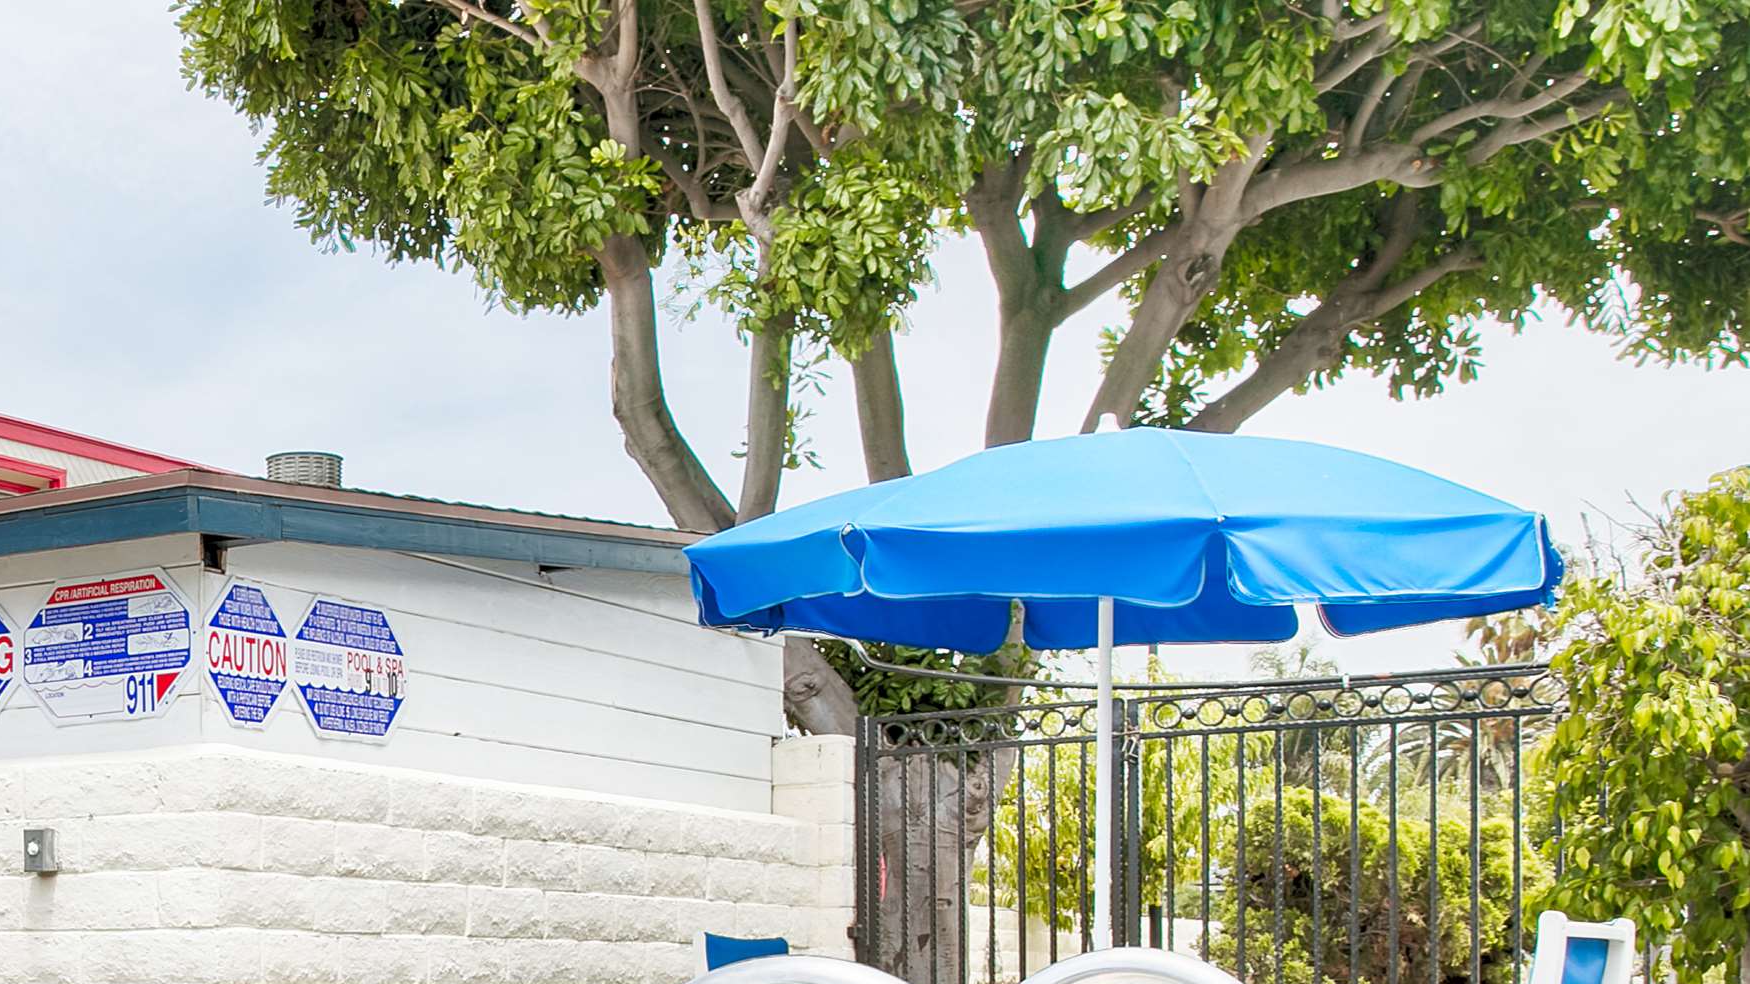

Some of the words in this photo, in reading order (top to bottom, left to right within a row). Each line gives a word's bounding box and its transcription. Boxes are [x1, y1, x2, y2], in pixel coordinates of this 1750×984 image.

[110, 577, 157, 595] RESPIRATION
[39, 608, 47, 625] 1
[84, 623, 94, 640] 2
[25, 649, 33, 664] 3
[209, 631, 287, 677] CAUTION
[83, 660, 94, 677] 4
[346, 651, 373, 673] POOL
[377, 656, 383, 674] &
[385, 657, 404, 678] SPA
[365, 669, 372, 693] 9
[387, 671, 398, 697] 10
[126, 673, 155, 714] 911
